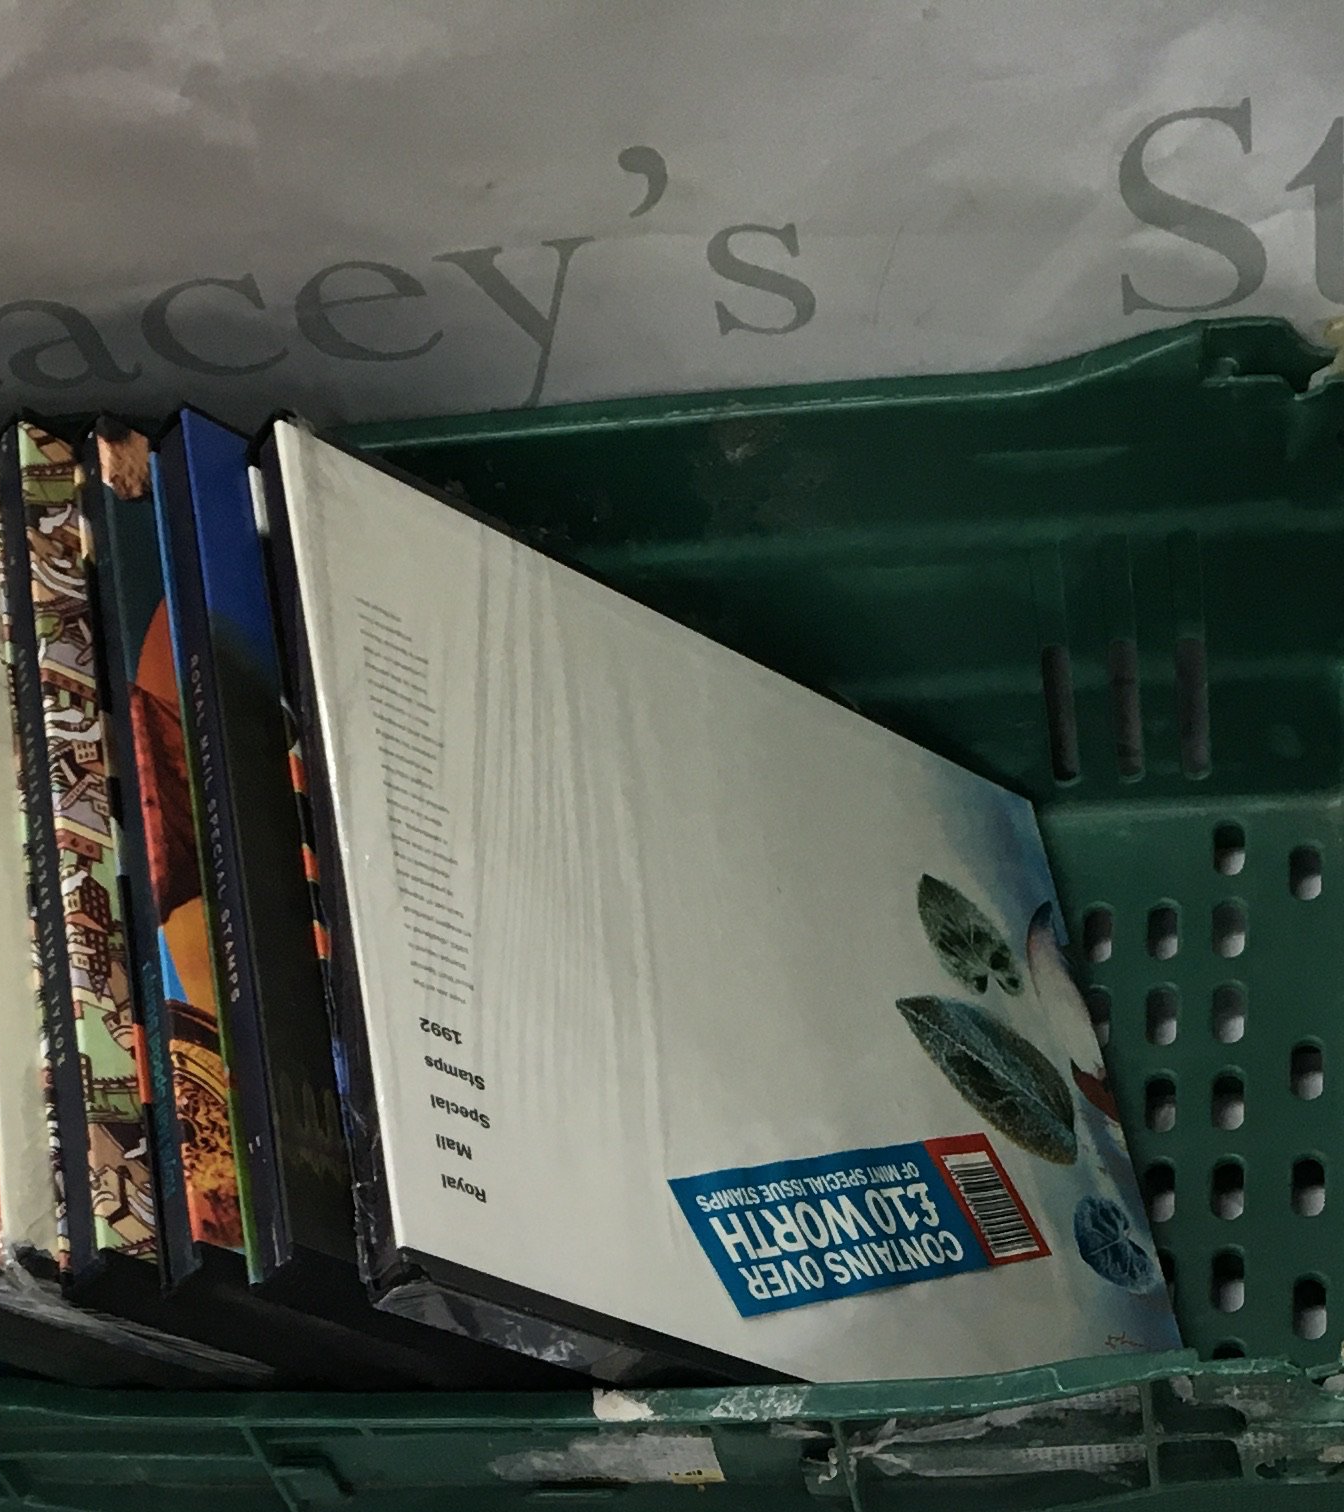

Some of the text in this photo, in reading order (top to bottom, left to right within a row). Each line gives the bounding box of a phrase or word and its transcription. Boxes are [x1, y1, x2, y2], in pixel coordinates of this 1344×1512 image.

[190, 653, 241, 1003] ROYAL MAIL SPECIAL STAMPS
[419, 1017, 463, 1045] 1992
[424, 1055, 485, 1091] Stamps
[430, 1093, 491, 1129] Special
[435, 1133, 473, 1160] Mail
[440, 1173, 487, 1204] Royal
[695, 1161, 920, 1213] OF MINT SPECIAL ISSUE STAMPS
[709, 1182, 941, 1263] £10 WORTH
[739, 1230, 964, 1301] CONTAINS OVER
